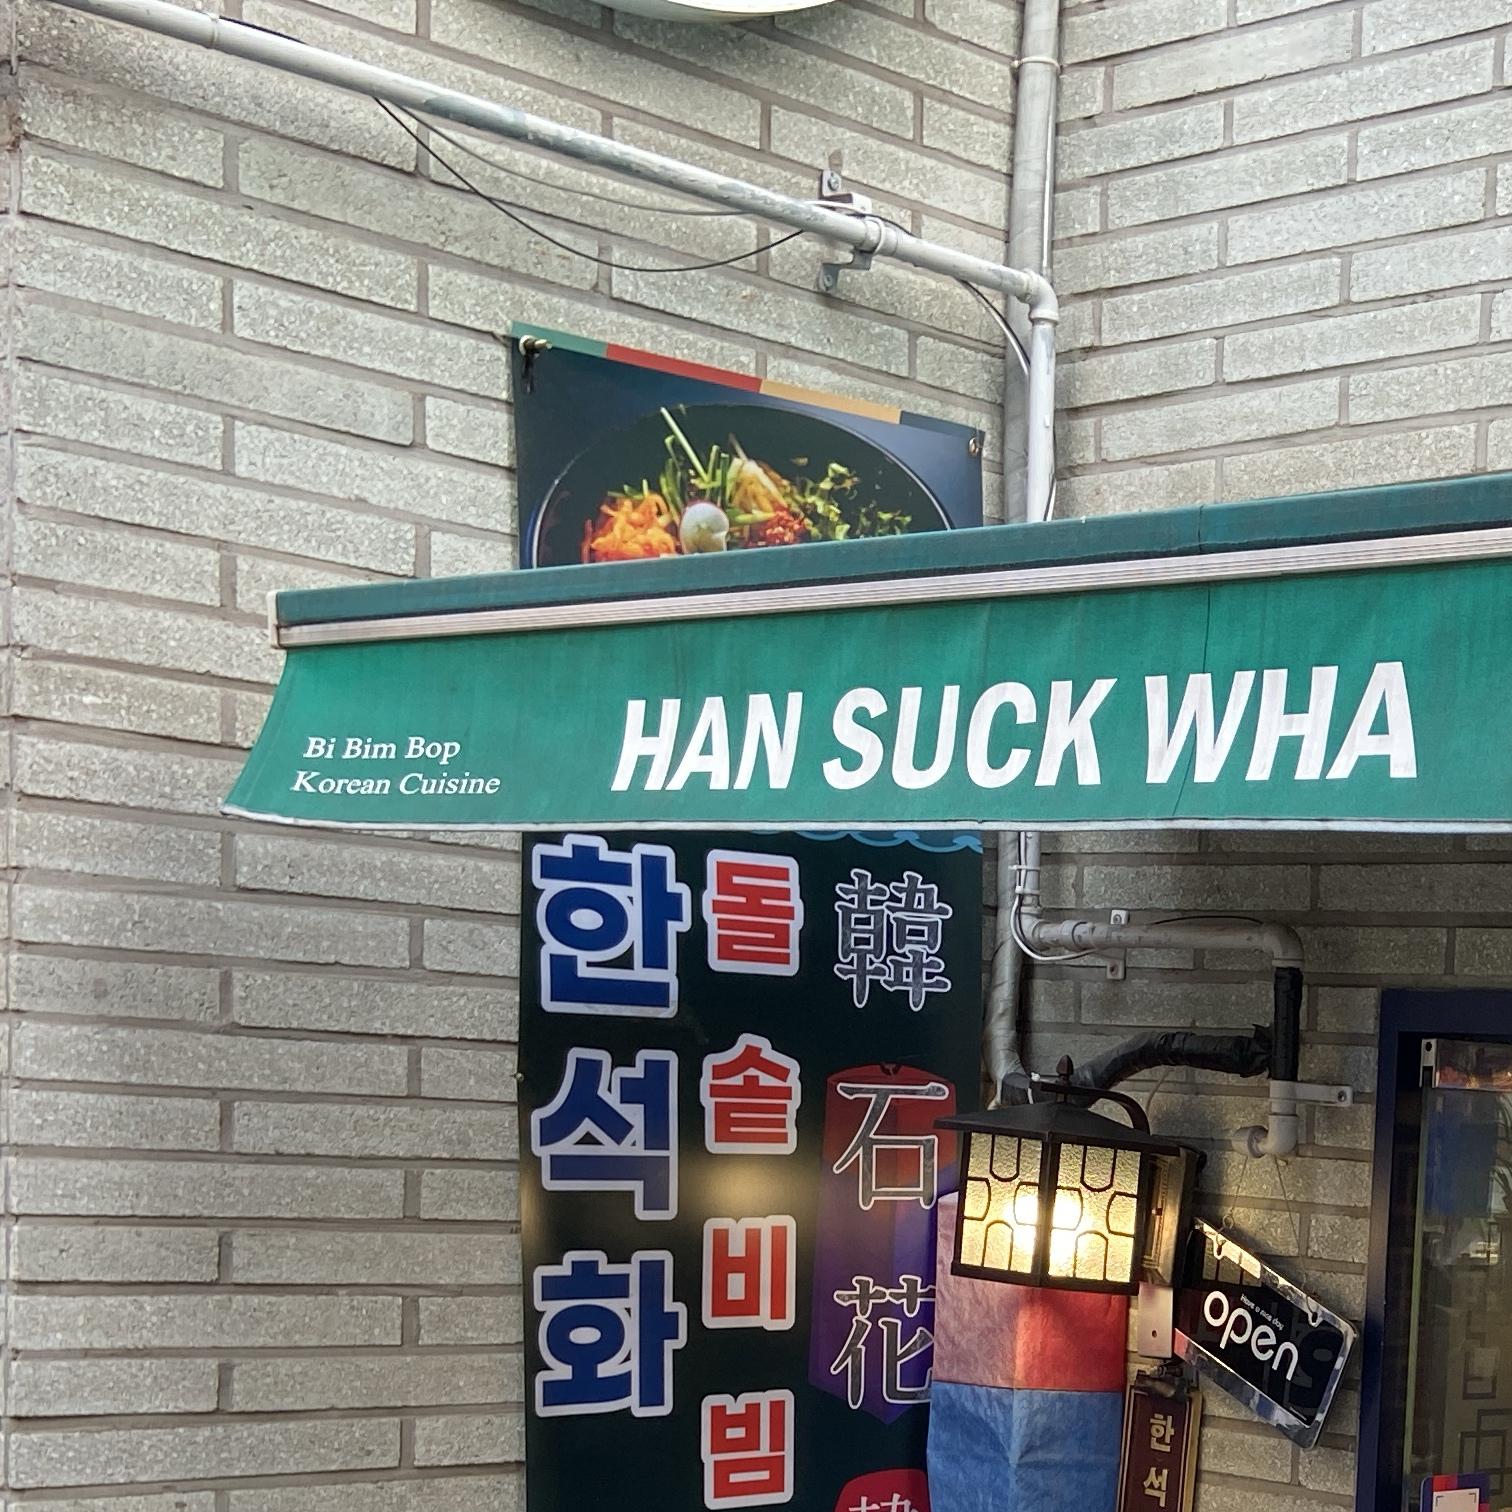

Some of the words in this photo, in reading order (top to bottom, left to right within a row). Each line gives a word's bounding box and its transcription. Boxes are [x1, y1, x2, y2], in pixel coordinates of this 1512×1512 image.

[303, 737, 335, 759] Bi
[342, 737, 396, 759] Bim
[404, 736, 460, 765] Bop
[611, 692, 803, 791] HAN
[822, 678, 1117, 790] SUCK
[1144, 661, 1418, 783] WHA
[290, 770, 391, 795] Korean
[399, 772, 501, 795] Cuisine
[531, 833, 692, 1417] 한석화
[1203, 1290, 1298, 1381] open
